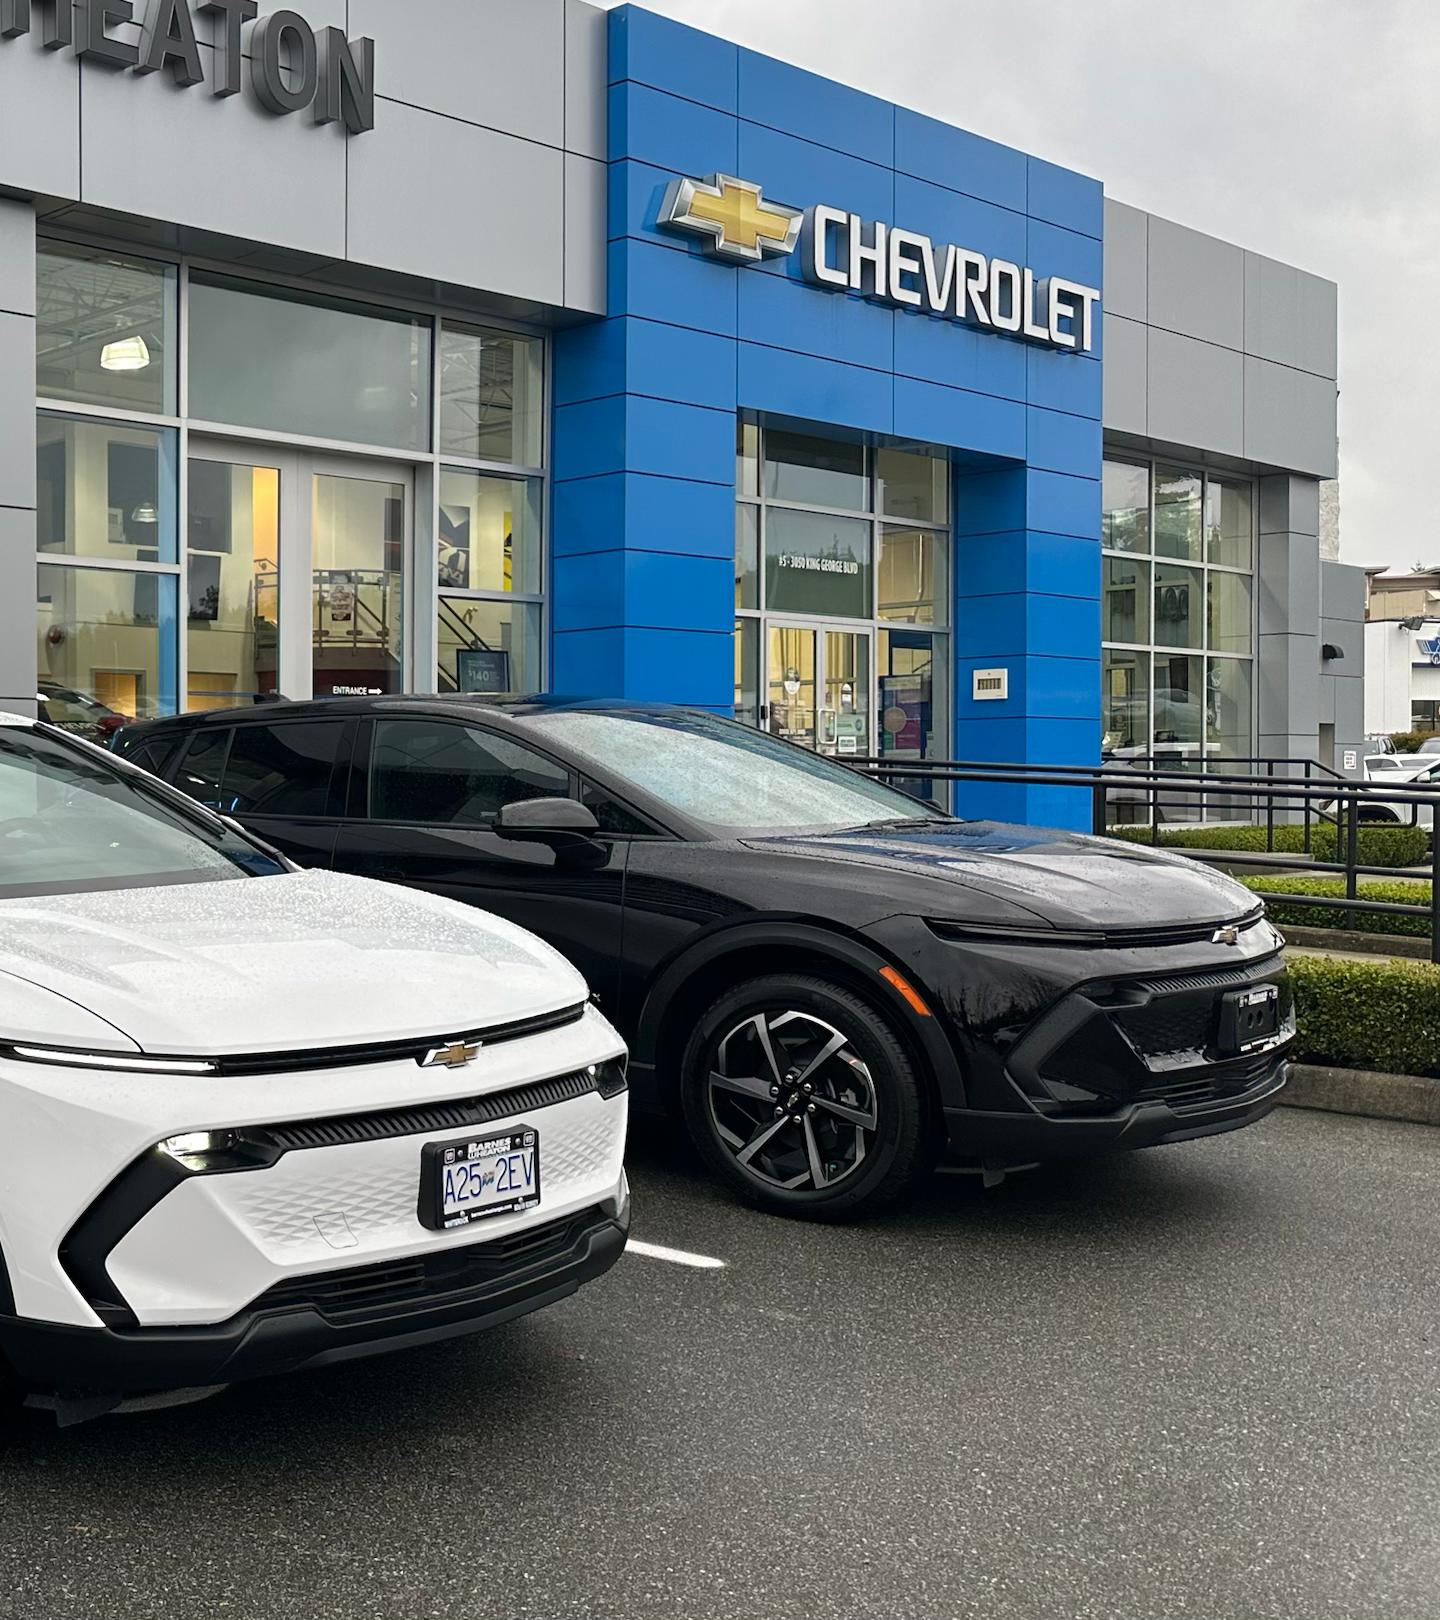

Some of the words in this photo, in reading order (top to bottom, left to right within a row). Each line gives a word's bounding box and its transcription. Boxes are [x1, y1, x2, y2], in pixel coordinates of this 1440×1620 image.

[804, 204, 1101, 353] CHEVROLET
[790, 555, 806, 569] 3050
[806, 557, 820, 571] KING
[820, 558, 843, 573] GEORGE
[843, 560, 859, 575] BLVD
[333, 685, 367, 696] ENTRANCE
[467, 1145, 511, 1160] WHEATON
[468, 1137, 512, 1153] BARNES
[444, 1162, 482, 1205] A25
[496, 1150, 534, 1193] 2EV
